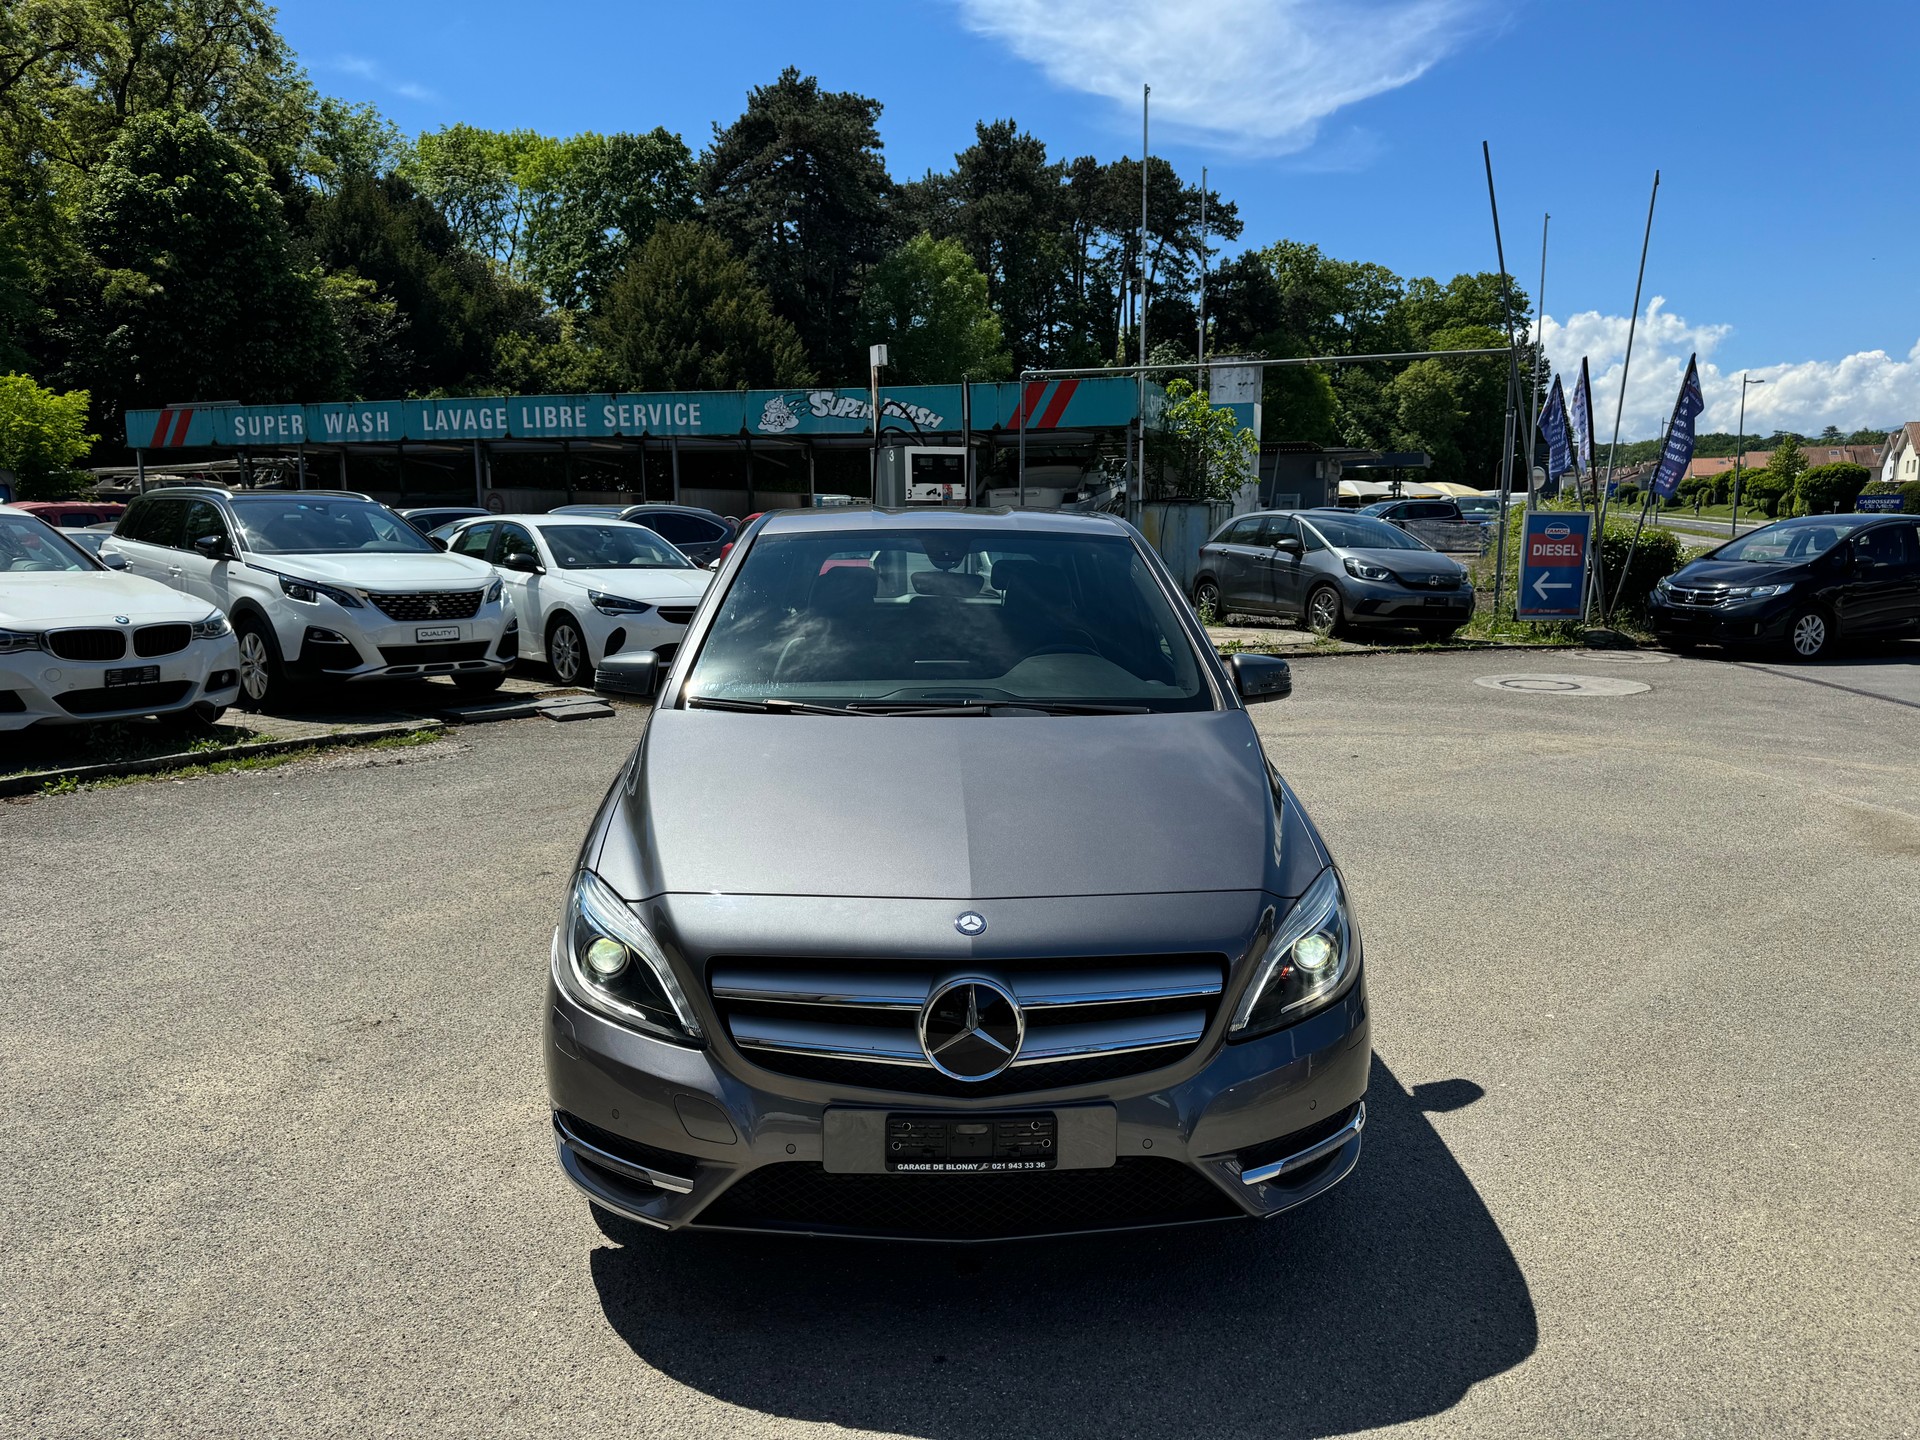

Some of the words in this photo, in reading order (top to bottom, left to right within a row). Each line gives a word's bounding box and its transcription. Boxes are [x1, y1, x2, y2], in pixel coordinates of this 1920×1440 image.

[234, 414, 304, 437] SUPER
[324, 411, 389, 434] WASH
[422, 407, 507, 431] LAVAGE
[522, 405, 587, 429] LIBRE
[603, 402, 701, 427] SERVICE
[888, 449, 895, 462] 3
[906, 488, 913, 499] 3
[1532, 544, 1579, 556] DIESEL
[897, 1163, 931, 1171] GARAGE
[933, 1163, 944, 1171] DE
[945, 1163, 978, 1171] BLONAY
[991, 1162, 1006, 1170] 021
[1008, 1162, 1023, 1170] 943
[1035, 1161, 1046, 1169] 36
